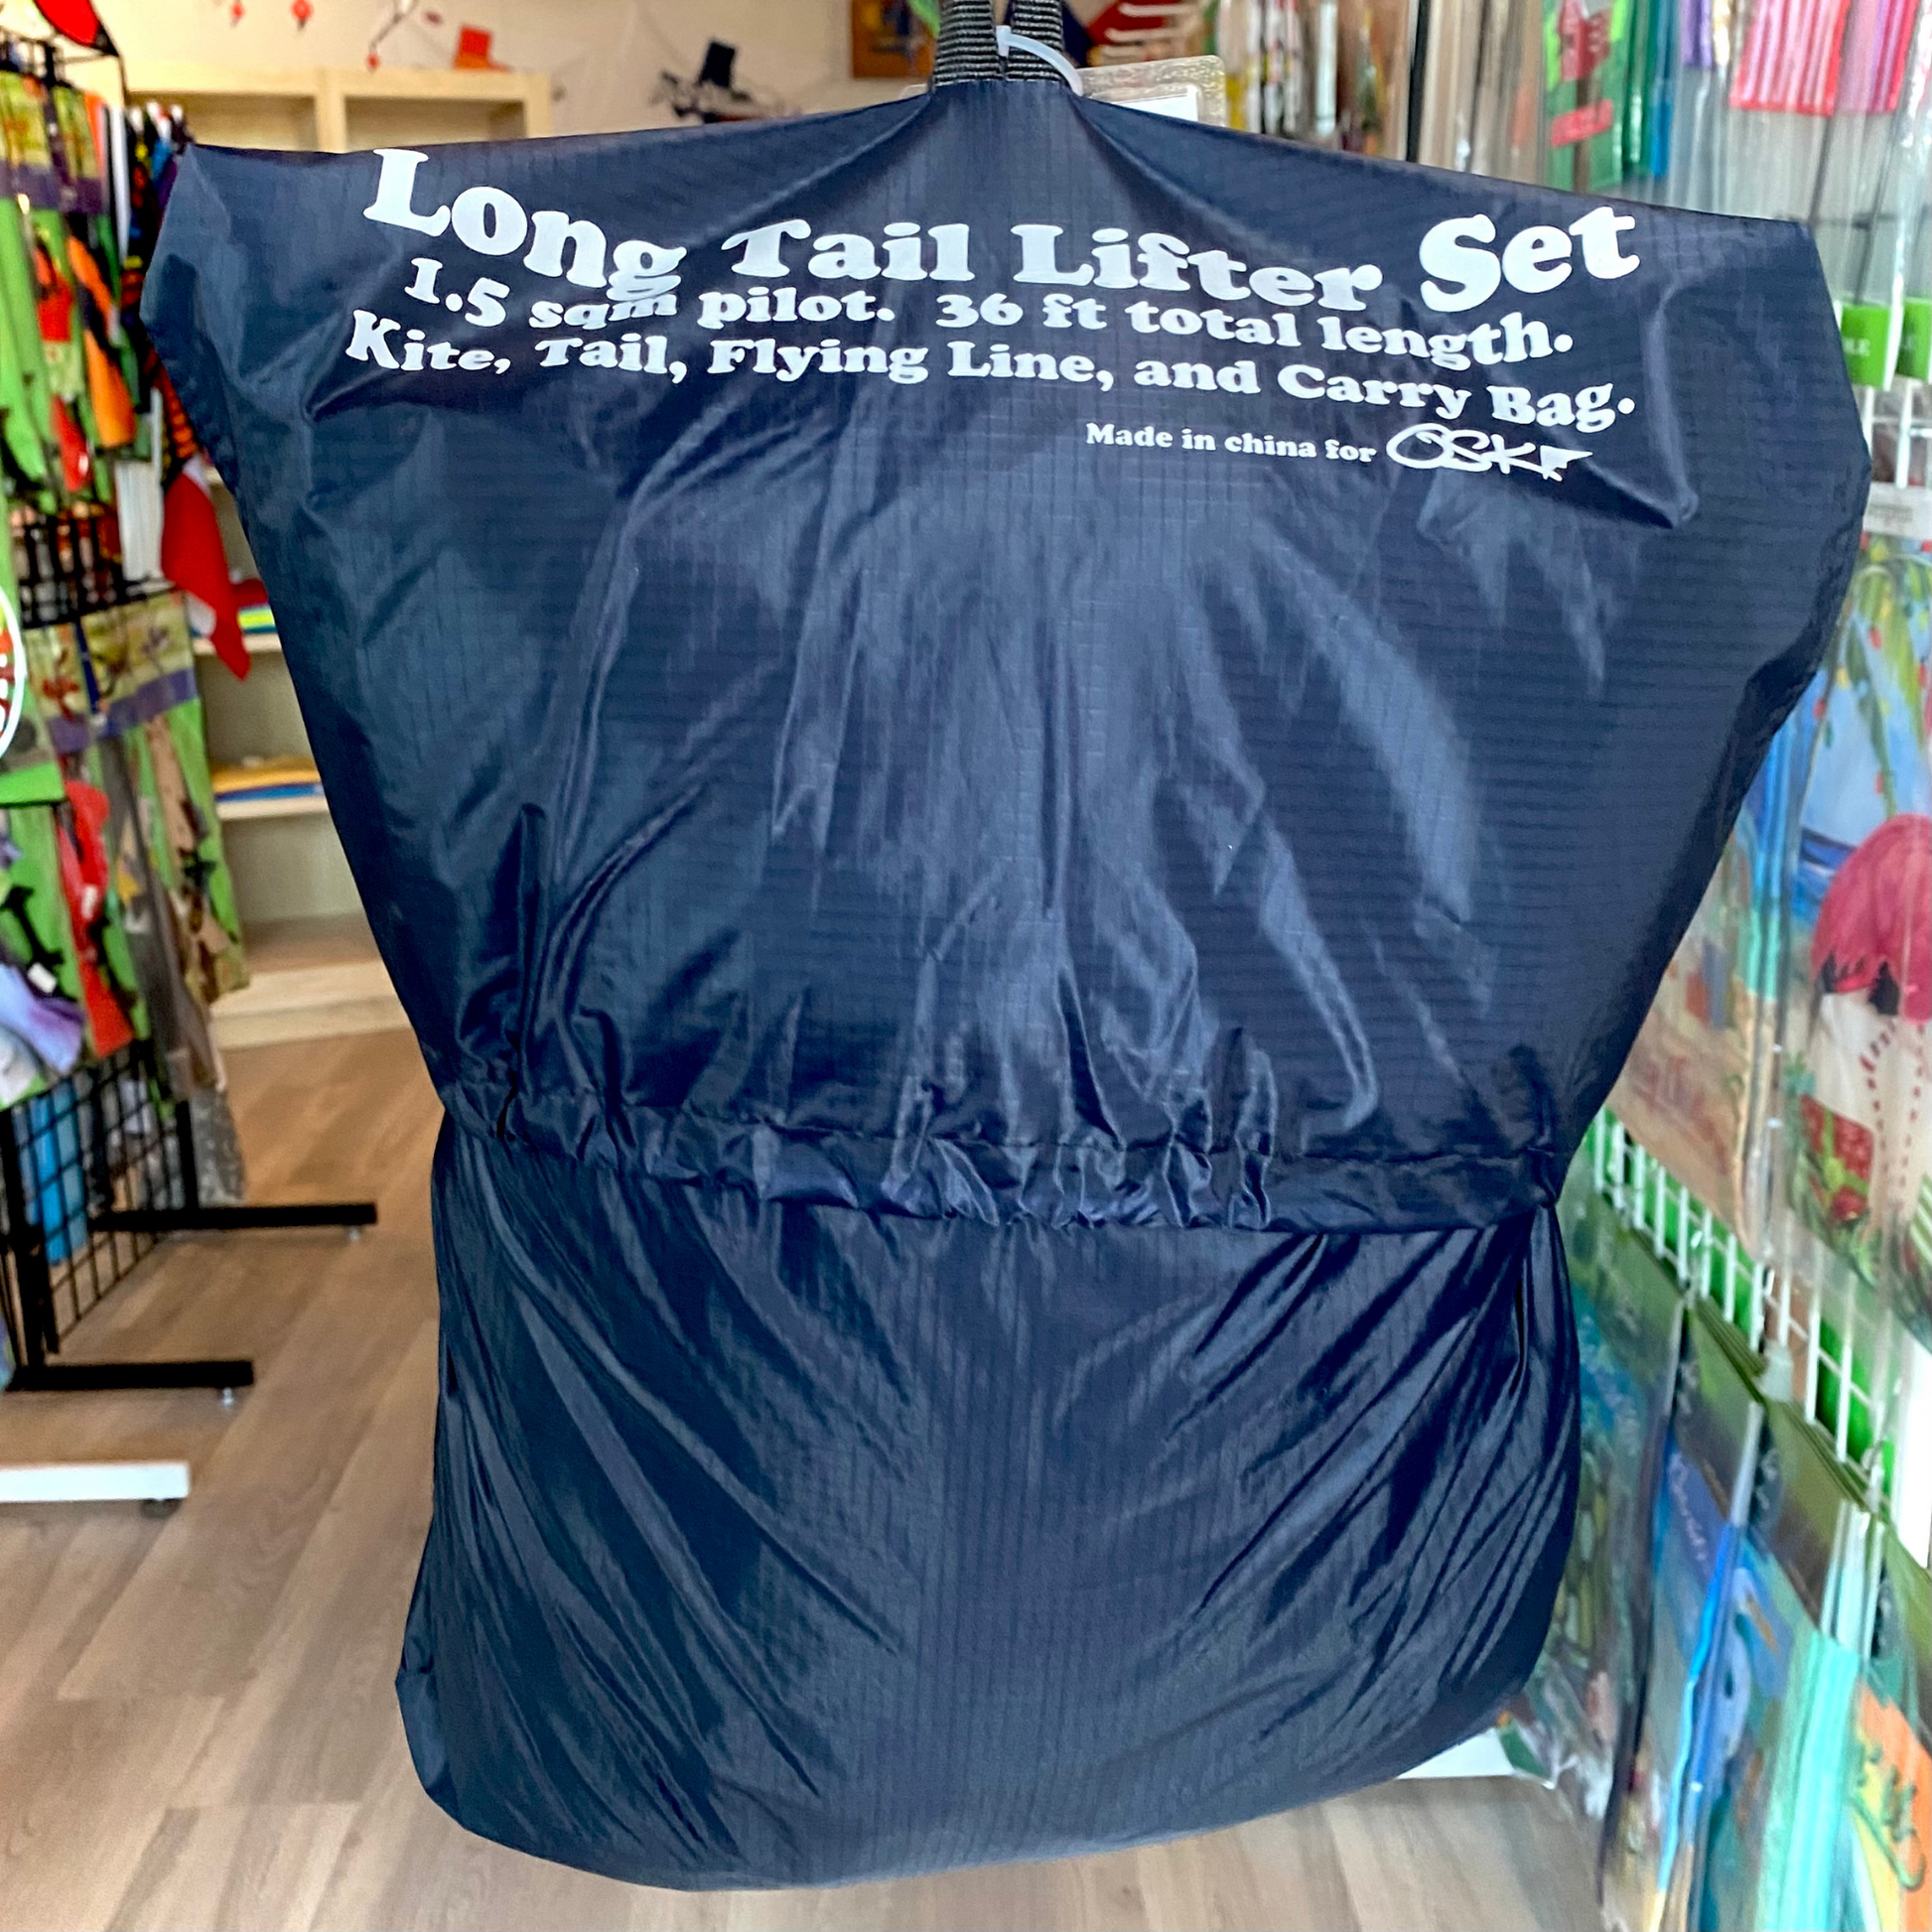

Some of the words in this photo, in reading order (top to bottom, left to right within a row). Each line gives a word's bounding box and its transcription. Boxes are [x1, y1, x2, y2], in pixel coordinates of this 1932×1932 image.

[363, 148, 687, 302] Long
[722, 219, 975, 282] Tail
[1011, 224, 1383, 312] Lifter
[1420, 206, 1640, 313] Set
[345, 310, 511, 371] Kite,
[534, 334, 688, 384] Tail,
[707, 338, 929, 384] Flying
[946, 342, 1115, 392] Line,
[1133, 360, 1262, 394] and
[1277, 363, 1472, 420] Carry
[1485, 383, 1635, 434] Bag.
[404, 257, 510, 328] 1.5
[528, 294, 677, 330] sqm
[697, 286, 896, 330] pilot.
[935, 292, 1024, 328] 36
[1041, 294, 1108, 331] ft
[1124, 300, 1302, 347] total
[1316, 312, 1574, 371] length.
[1085, 422, 1173, 448] Made
[1181, 428, 1216, 451] in
[1224, 433, 1317, 458] china
[1324, 439, 1377, 463] for
